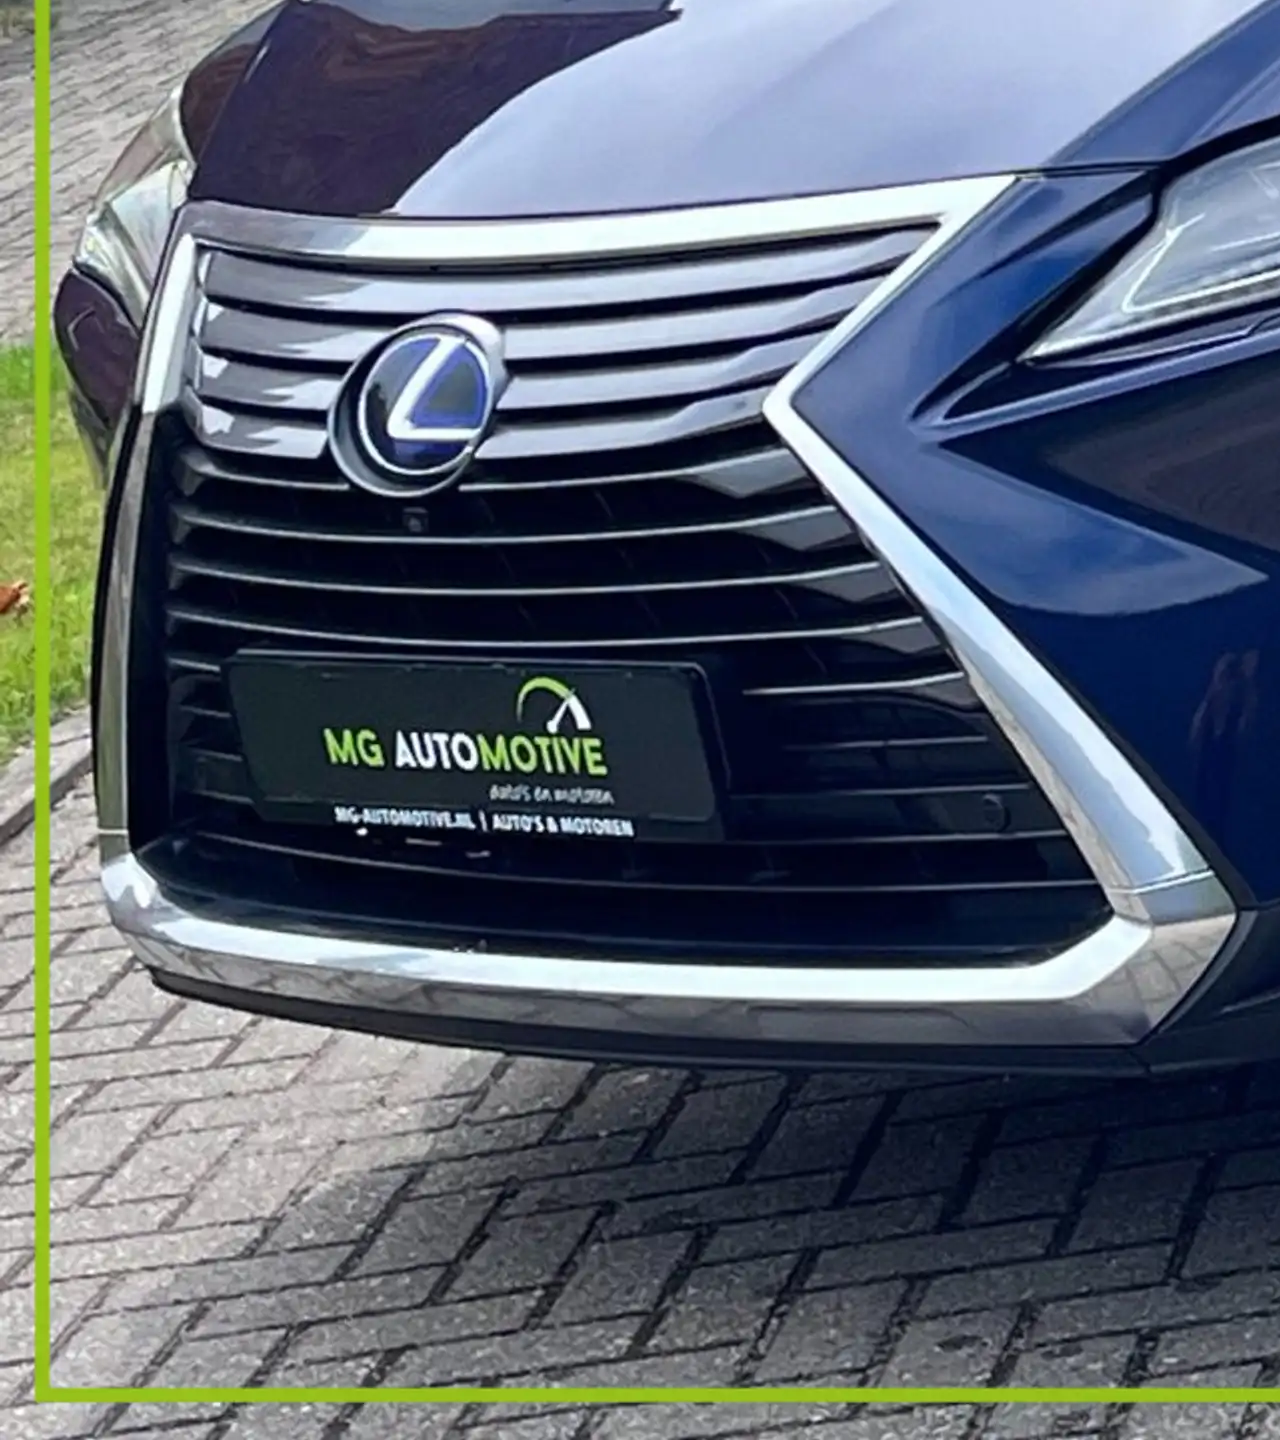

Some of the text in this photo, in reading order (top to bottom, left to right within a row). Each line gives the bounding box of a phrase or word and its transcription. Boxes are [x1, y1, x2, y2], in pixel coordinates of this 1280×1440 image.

[323, 727, 608, 776] MG AUTOMOTIVE
[492, 812, 545, 833] AUTO'S
[559, 815, 635, 838] MOTOREN
